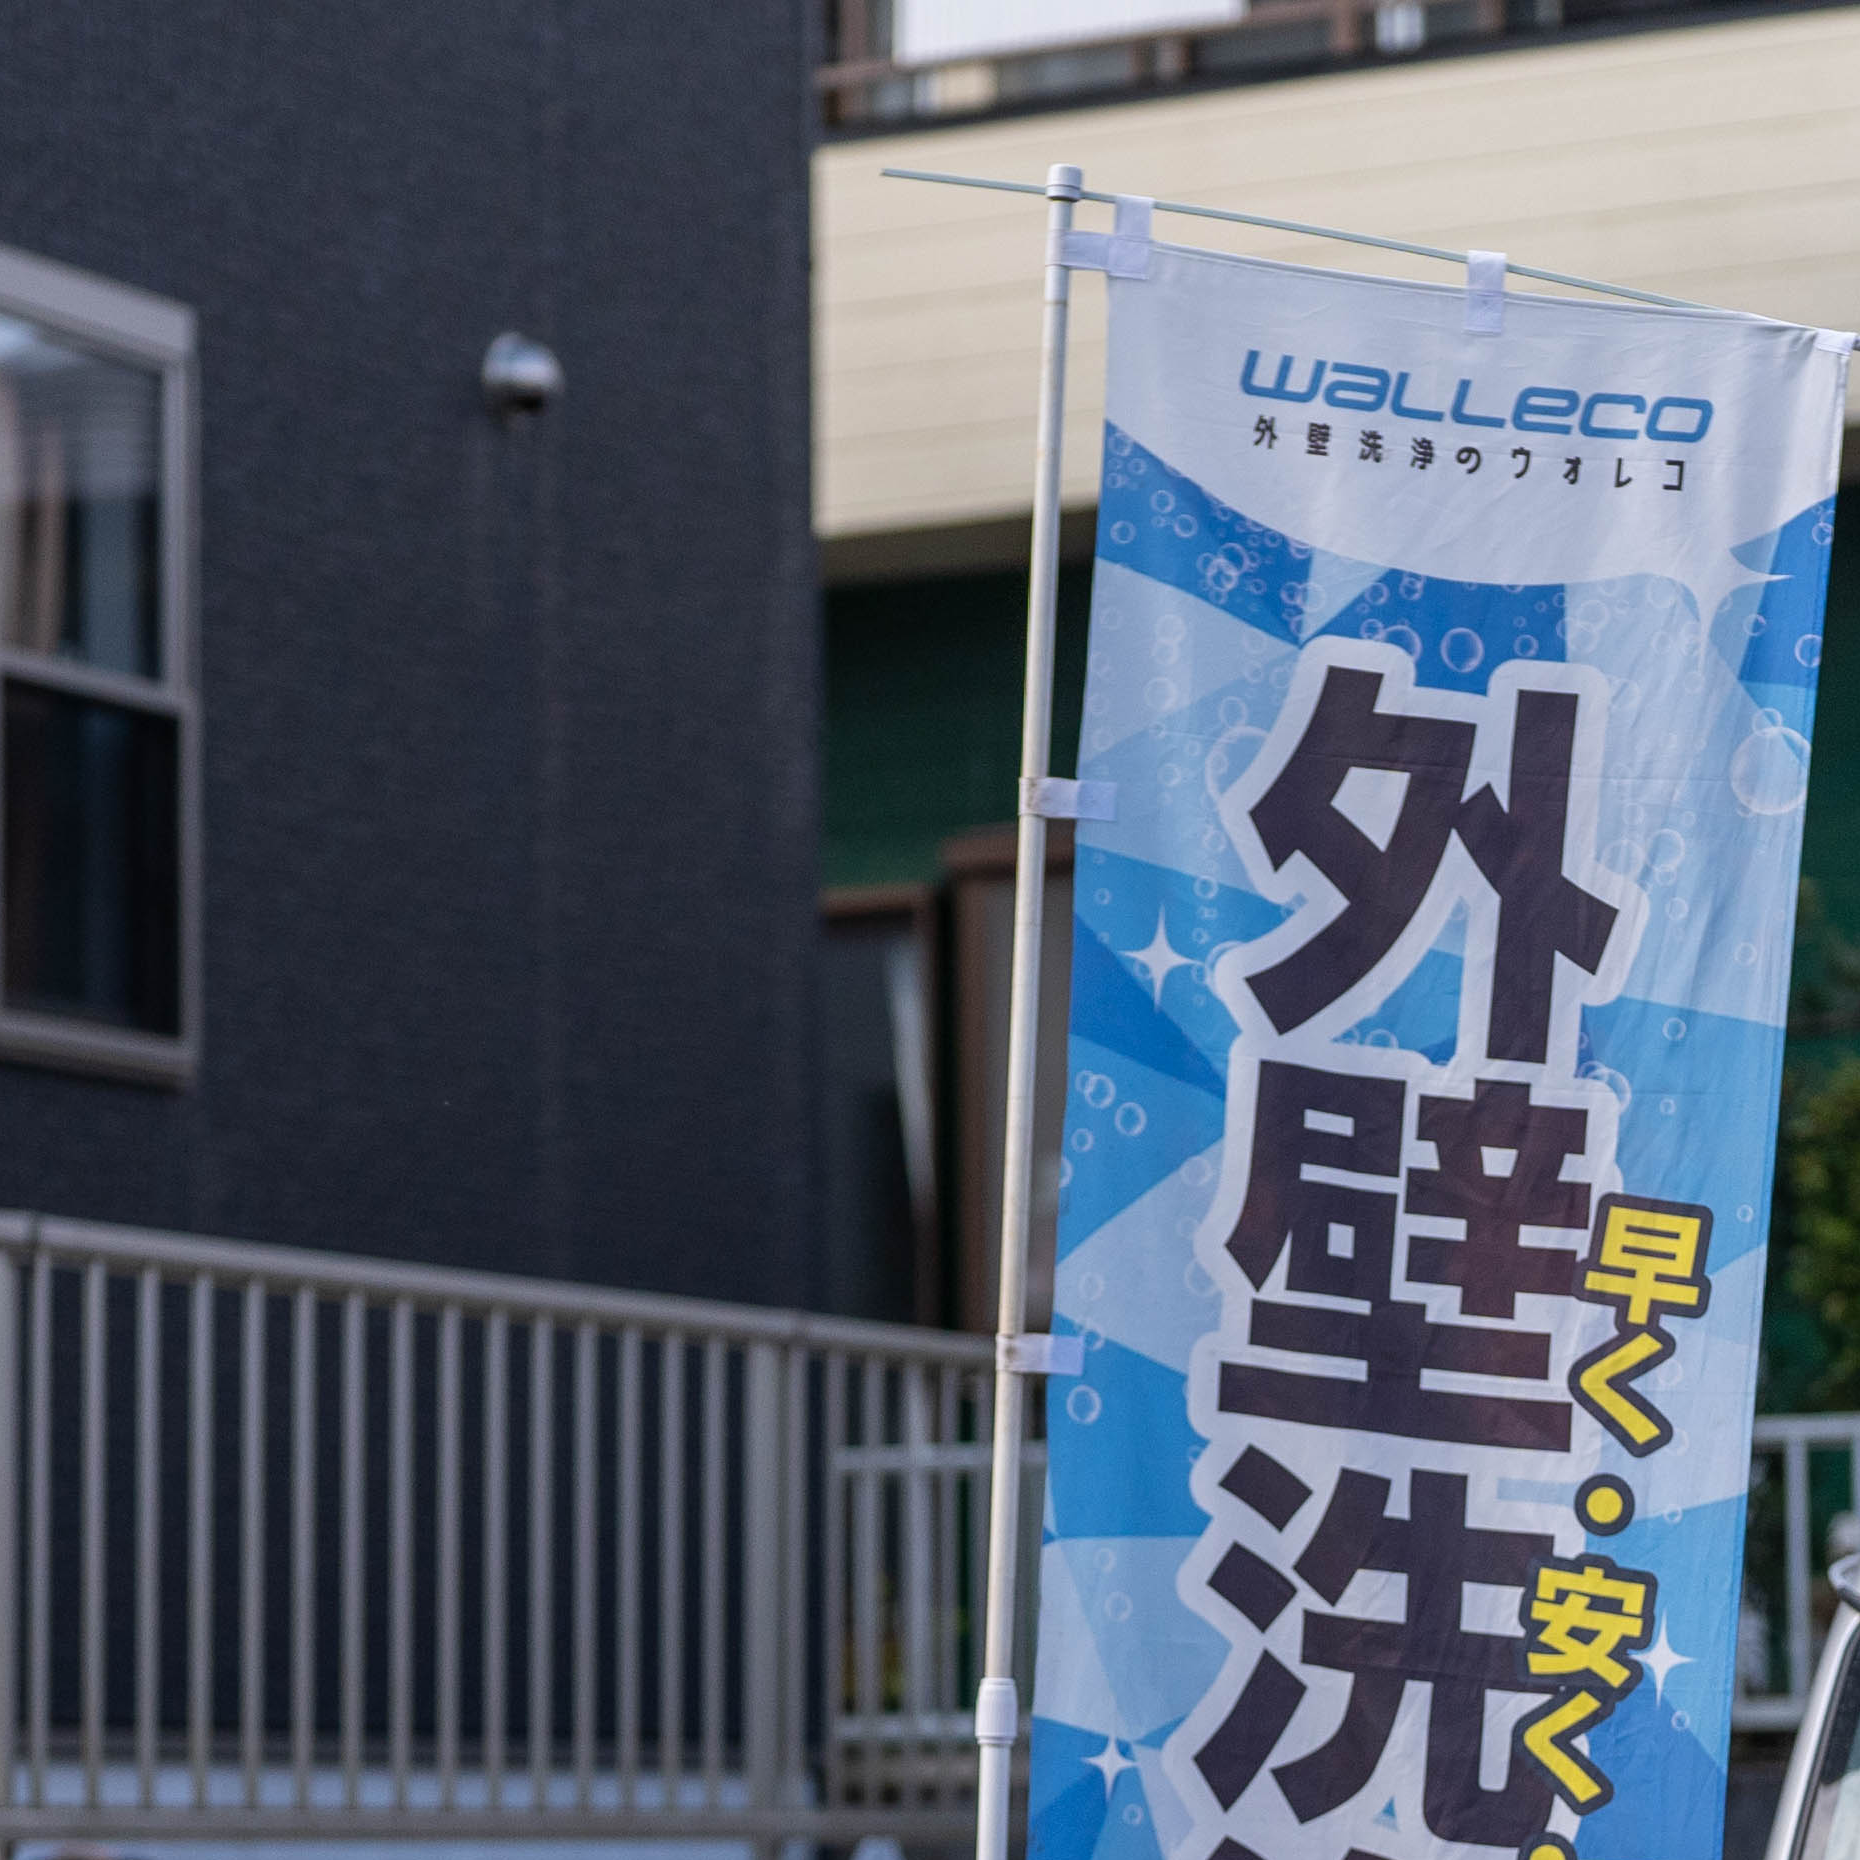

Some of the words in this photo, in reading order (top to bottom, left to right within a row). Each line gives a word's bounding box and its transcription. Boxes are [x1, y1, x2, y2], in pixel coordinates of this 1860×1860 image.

[1253, 413, 1686, 493] 外壁洗浄のウオレコ
